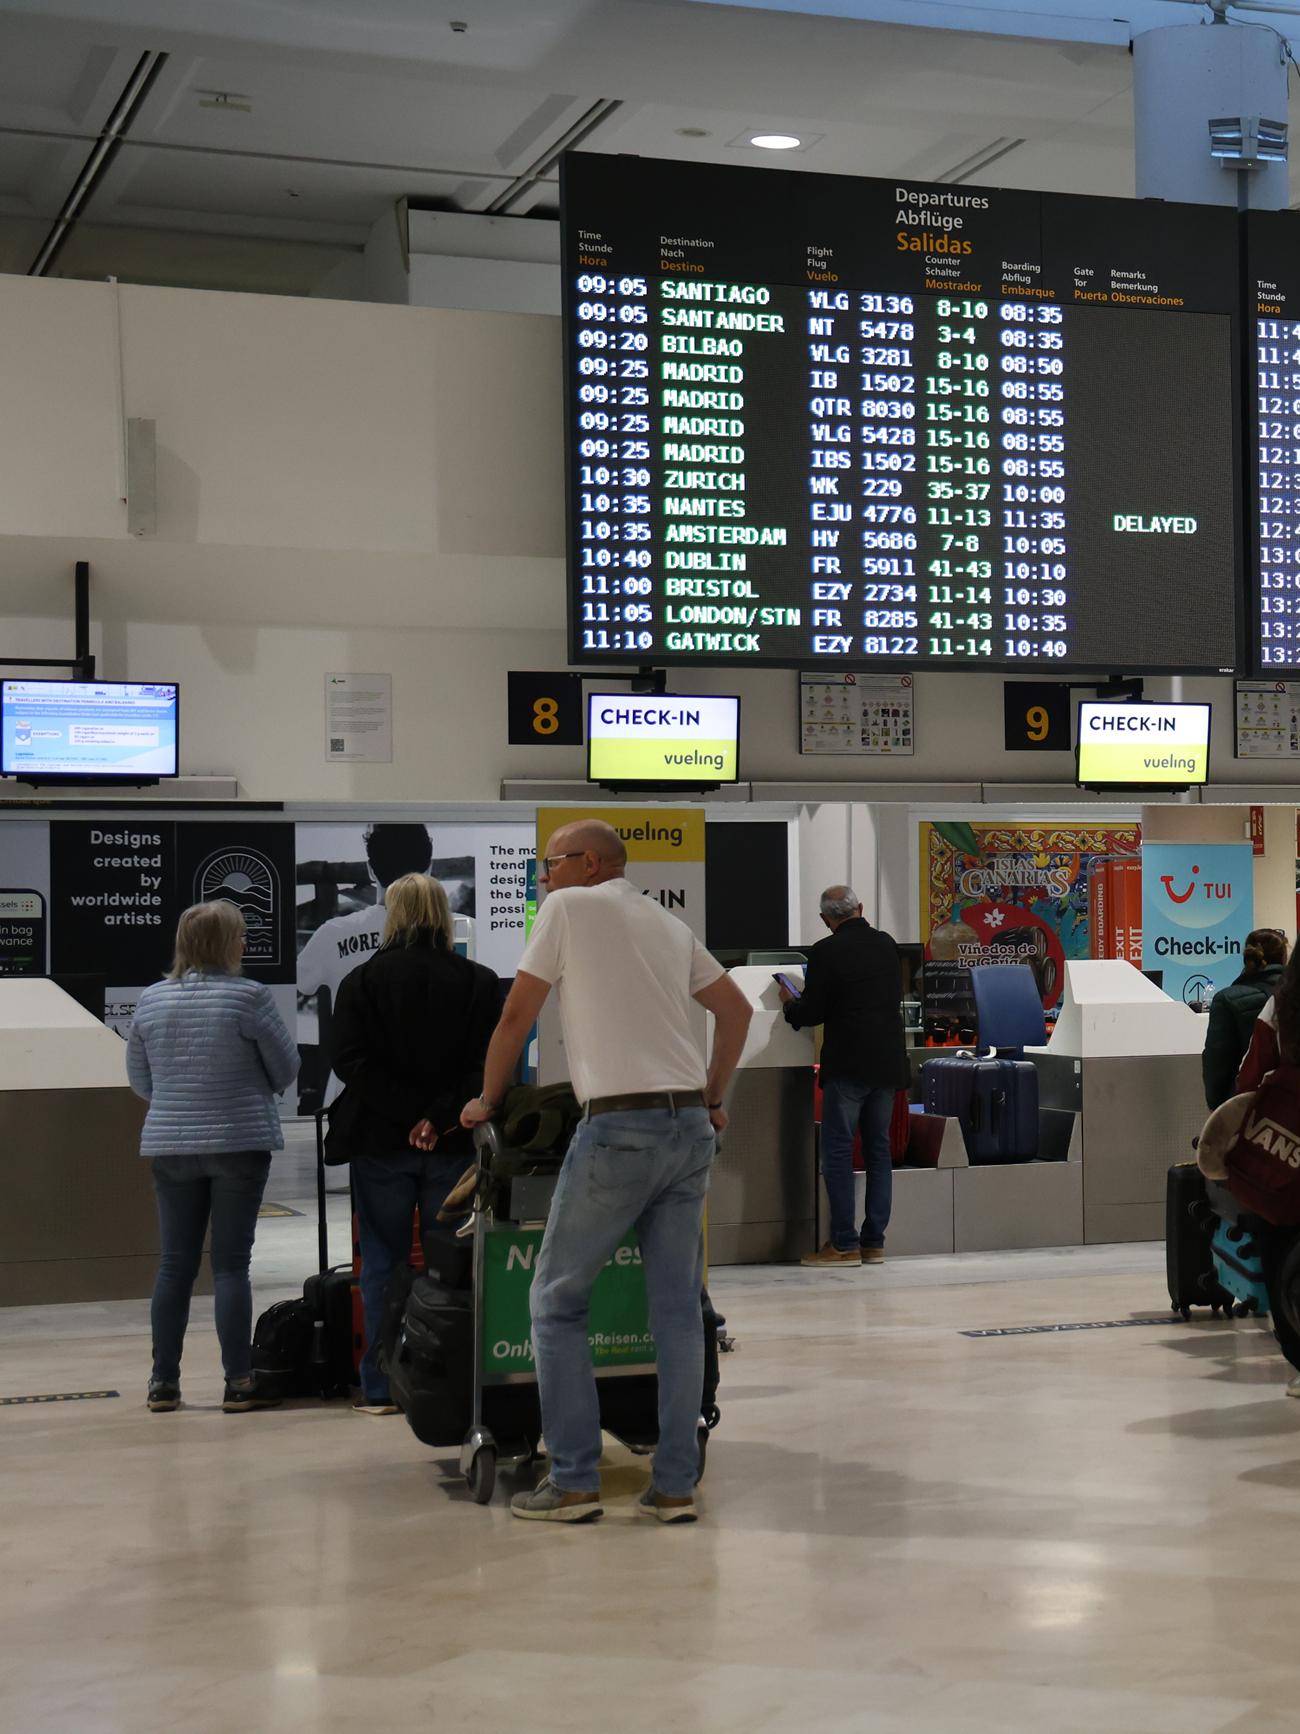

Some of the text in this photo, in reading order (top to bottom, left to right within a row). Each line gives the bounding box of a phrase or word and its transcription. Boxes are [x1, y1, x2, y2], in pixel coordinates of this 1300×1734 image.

[895, 188, 989, 209] Departures
[895, 210, 963, 231] Abflüge
[578, 230, 602, 240] Time
[660, 236, 715, 249] Destination
[578, 242, 613, 254] Stunde
[896, 232, 973, 255] Salidas
[579, 254, 608, 267] Hora
[660, 248, 685, 259] Nach
[660, 260, 705, 273] Destino
[578, 274, 1063, 324] 09:05 SANTIAGO VLG 3136 8-10 08:35
[578, 302, 1063, 350] 09:05 SANTANDER NT 5478 3-4 08:35
[582, 493, 1197, 534] 10:35 NANTES EJU 4776 11-13 11:35 DELAYED
[532, 697, 559, 735] 8
[600, 709, 701, 725] CHECK-IN
[1026, 706, 1049, 741] 9
[1089, 716, 1176, 731] CHECK-IN
[664, 750, 724, 770] vueling
[1143, 754, 1196, 773] vueling
[90, 830, 162, 849] Designs
[615, 821, 683, 847] ueling
[490, 845, 514, 856] The
[93, 855, 162, 868] created
[994, 858, 1036, 871] ISLAS
[140, 874, 162, 890] by
[960, 868, 1071, 897] CANARIAS
[490, 889, 512, 899] the
[1203, 883, 1231, 899] TUI
[71, 893, 162, 906] worldwide
[1097, 882, 1105, 937] BOARDING
[104, 912, 162, 926] artists
[11, 925, 33, 936] bag
[337, 931, 380, 958] MORE
[958, 943, 1037, 955] Viñedos de
[1115, 926, 1125, 960] EXIT
[1129, 926, 1142, 961] EXIT
[1154, 936, 1241, 956] Check-in
[958, 957, 976, 968] La
[1047, 1320, 1107, 1332] your
